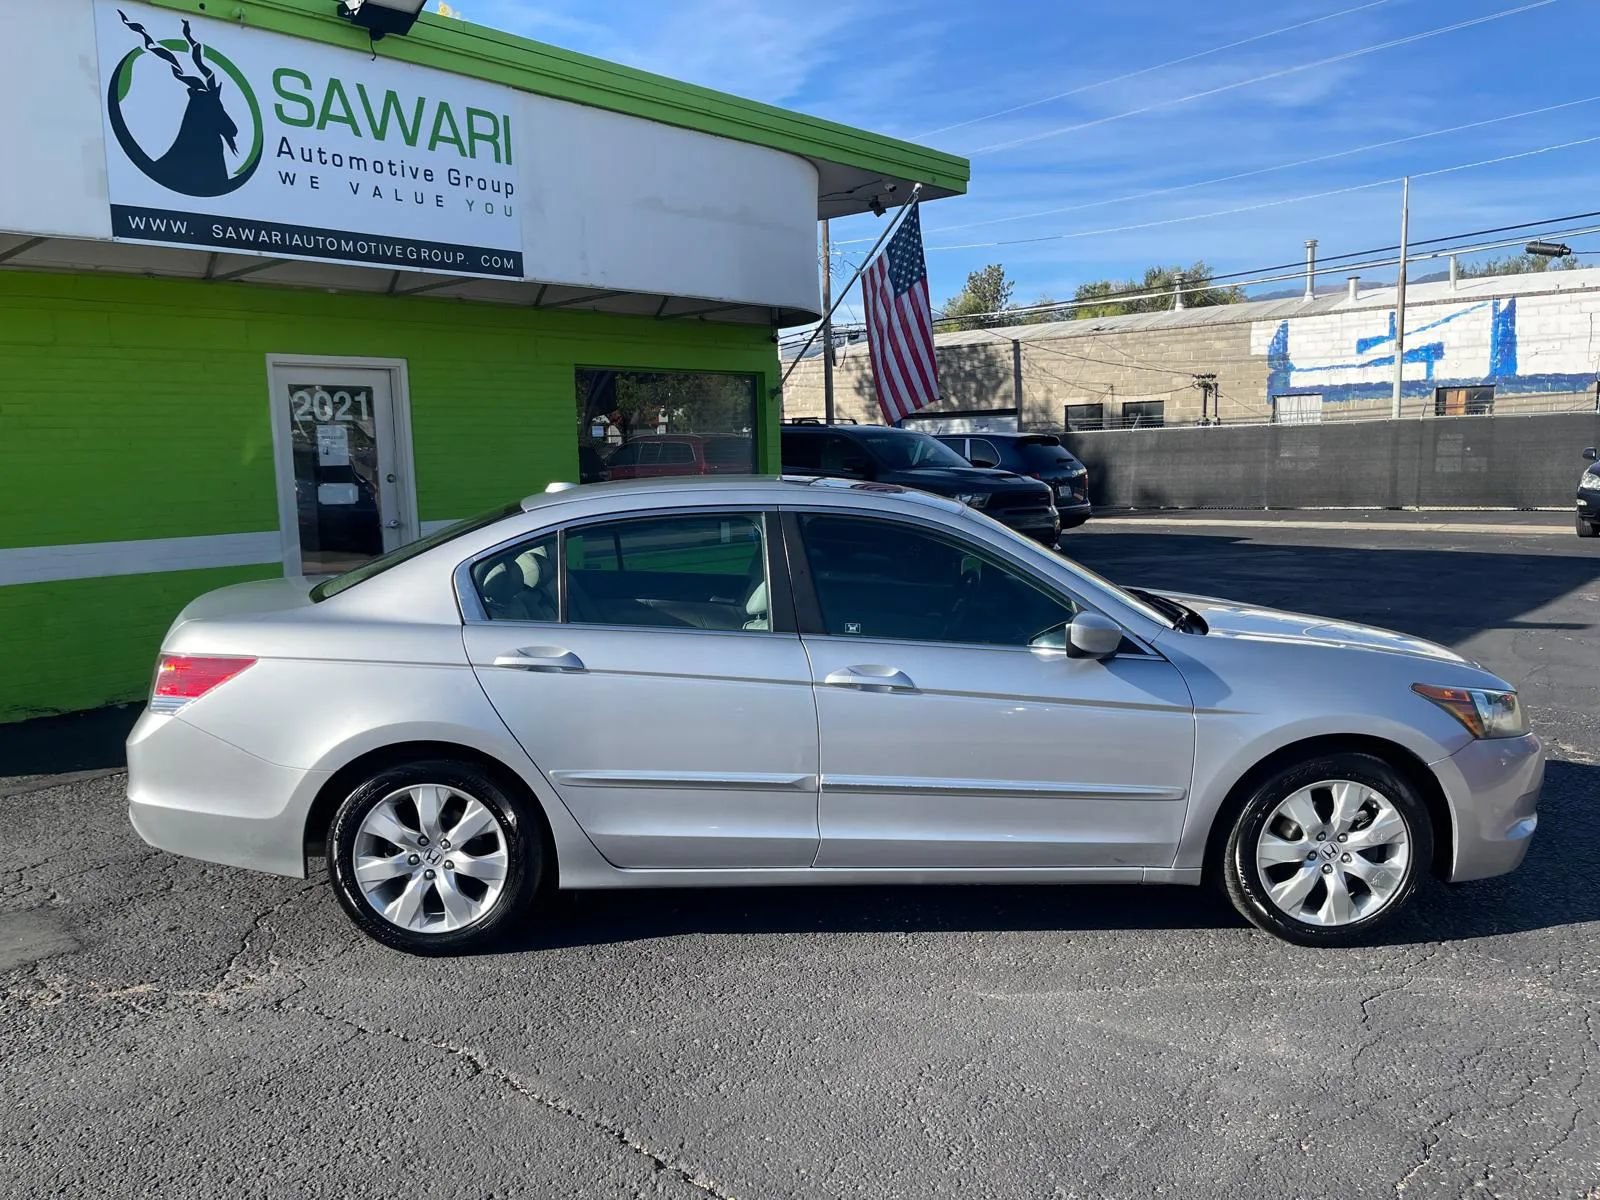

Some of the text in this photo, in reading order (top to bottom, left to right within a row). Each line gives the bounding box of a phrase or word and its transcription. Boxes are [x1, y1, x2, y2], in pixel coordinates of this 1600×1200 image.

[272, 67, 513, 166] SAWARI
[276, 136, 514, 199] Automotive Group
[278, 170, 513, 217] WE VALUE YOU
[481, 255, 514, 269] COM
[292, 390, 369, 421] 2021
